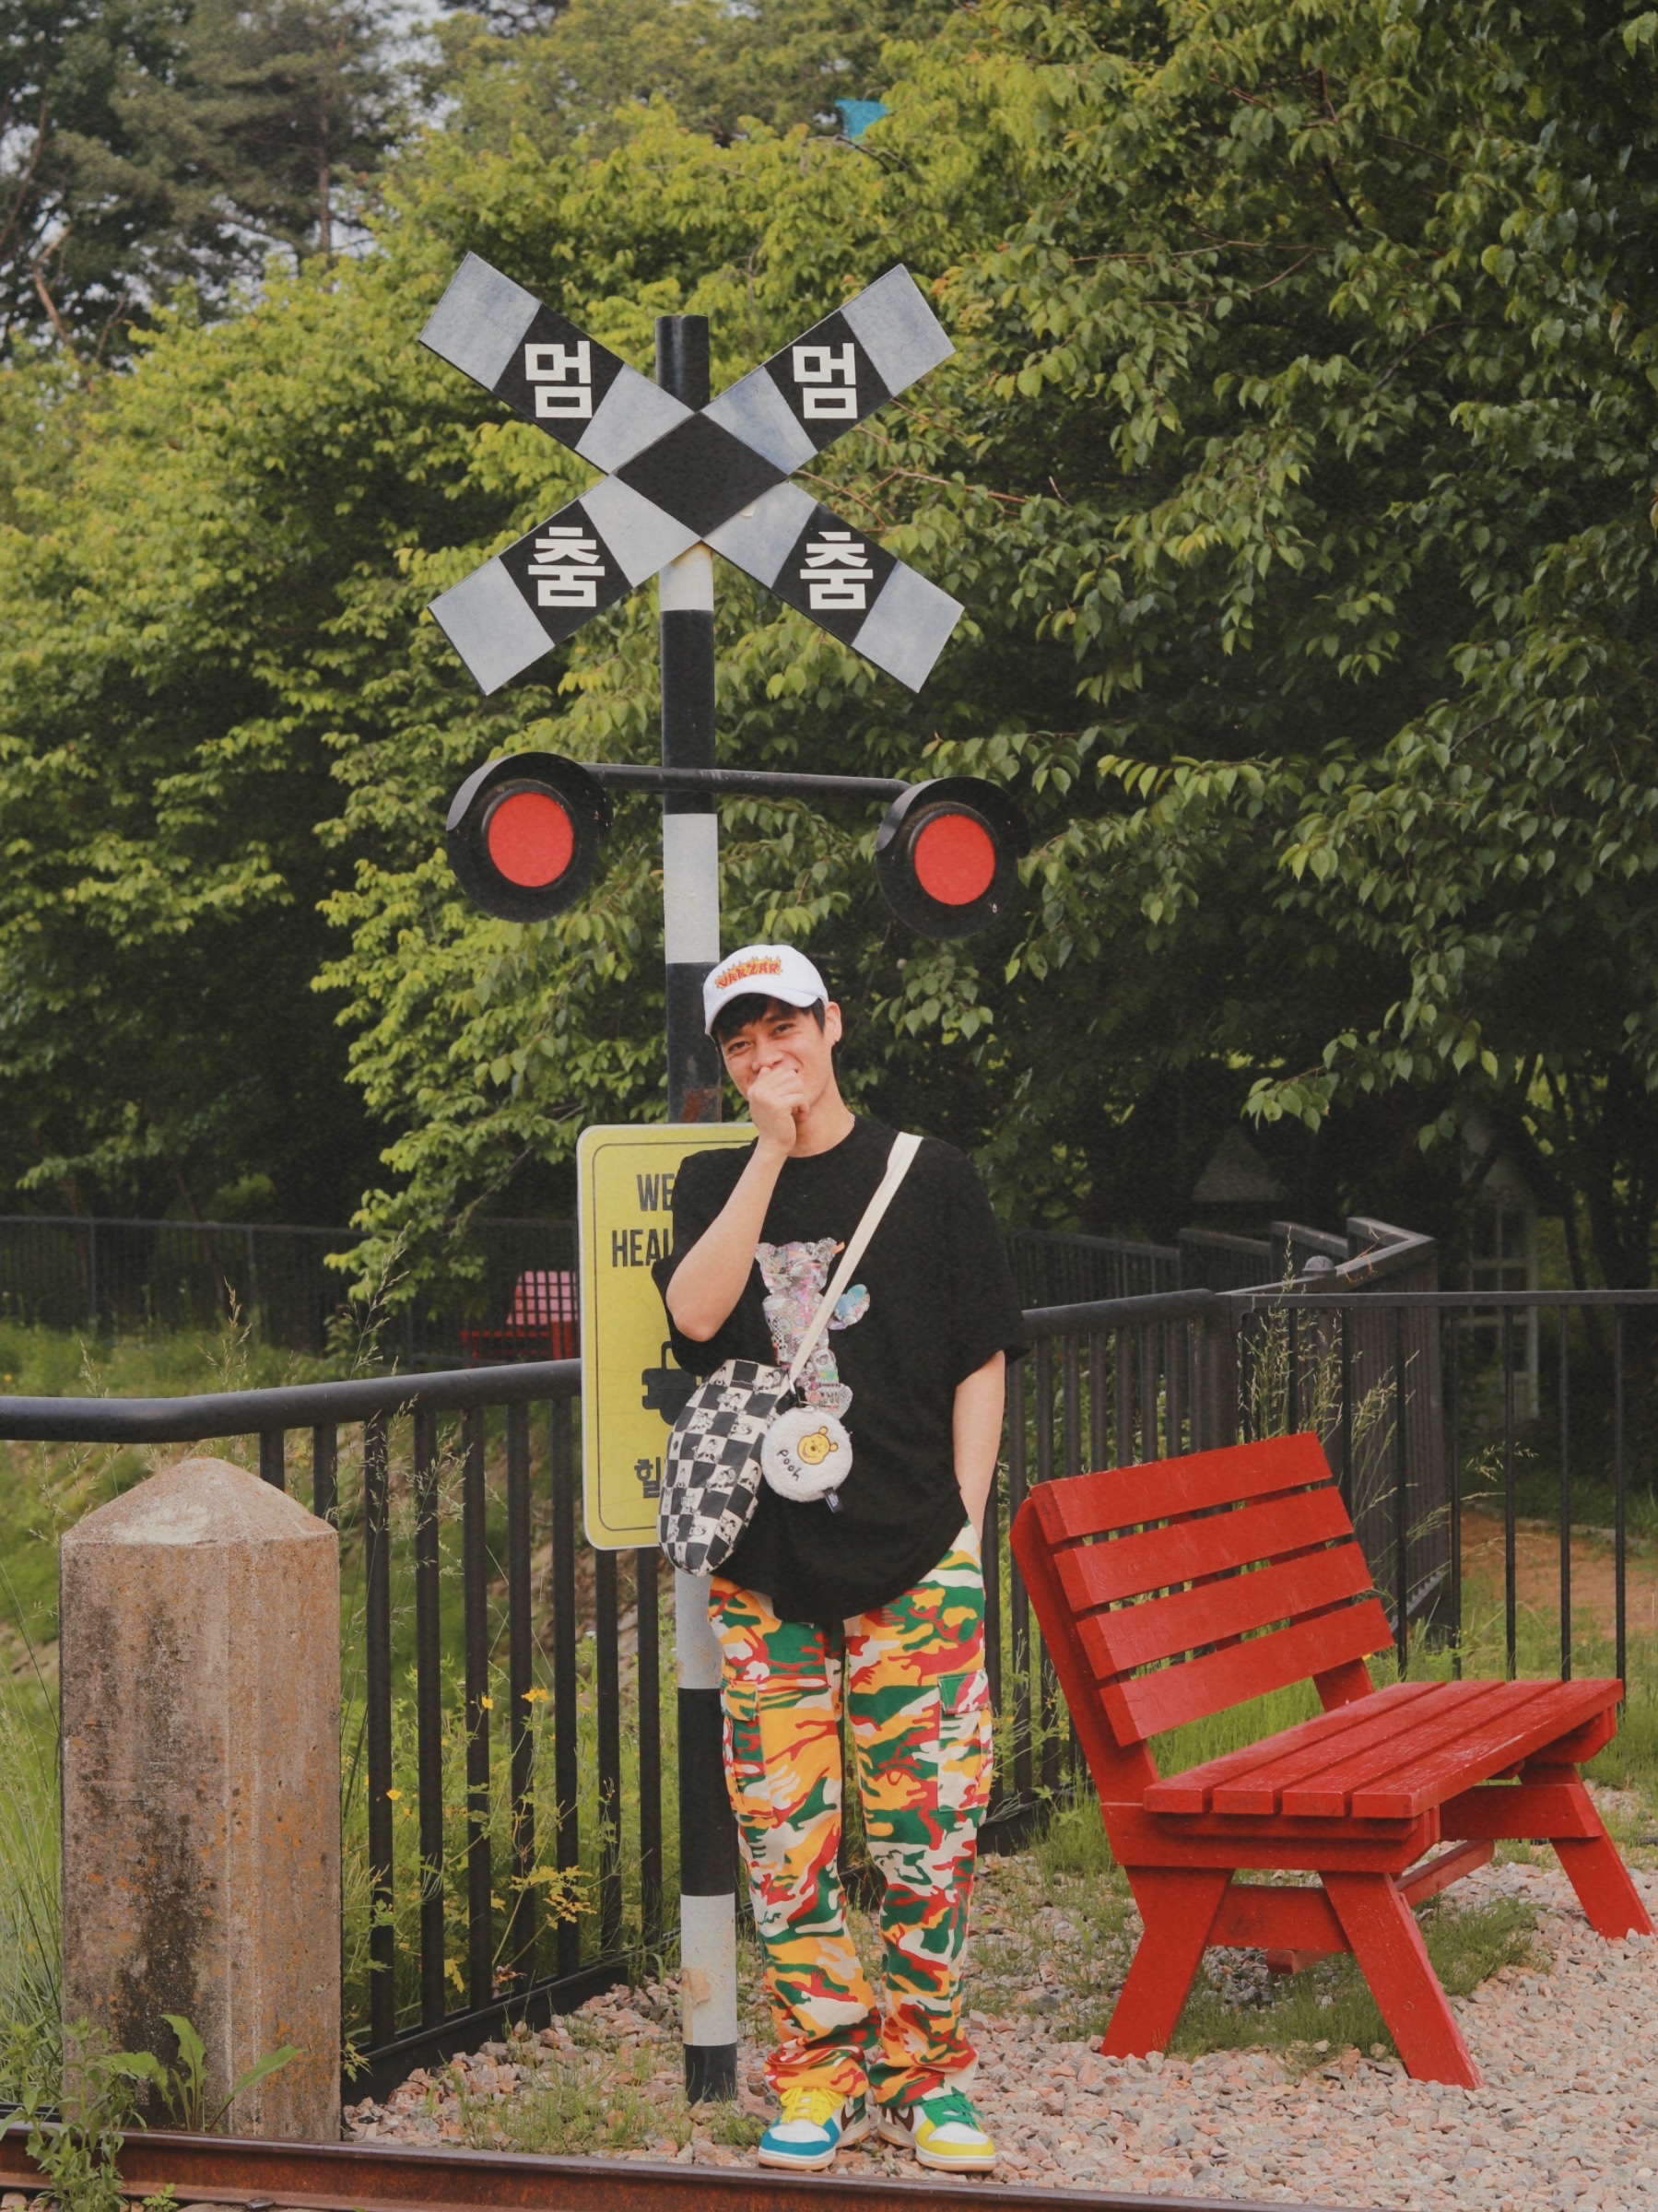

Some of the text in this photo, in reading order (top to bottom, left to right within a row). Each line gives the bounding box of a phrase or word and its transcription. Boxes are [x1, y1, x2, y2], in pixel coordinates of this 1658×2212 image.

[524, 340, 593, 418] 멈
[792, 342, 858, 419] 멈
[527, 526, 606, 607] 춤
[799, 531, 874, 610] 춤
[634, 1456, 661, 1499] 힐
